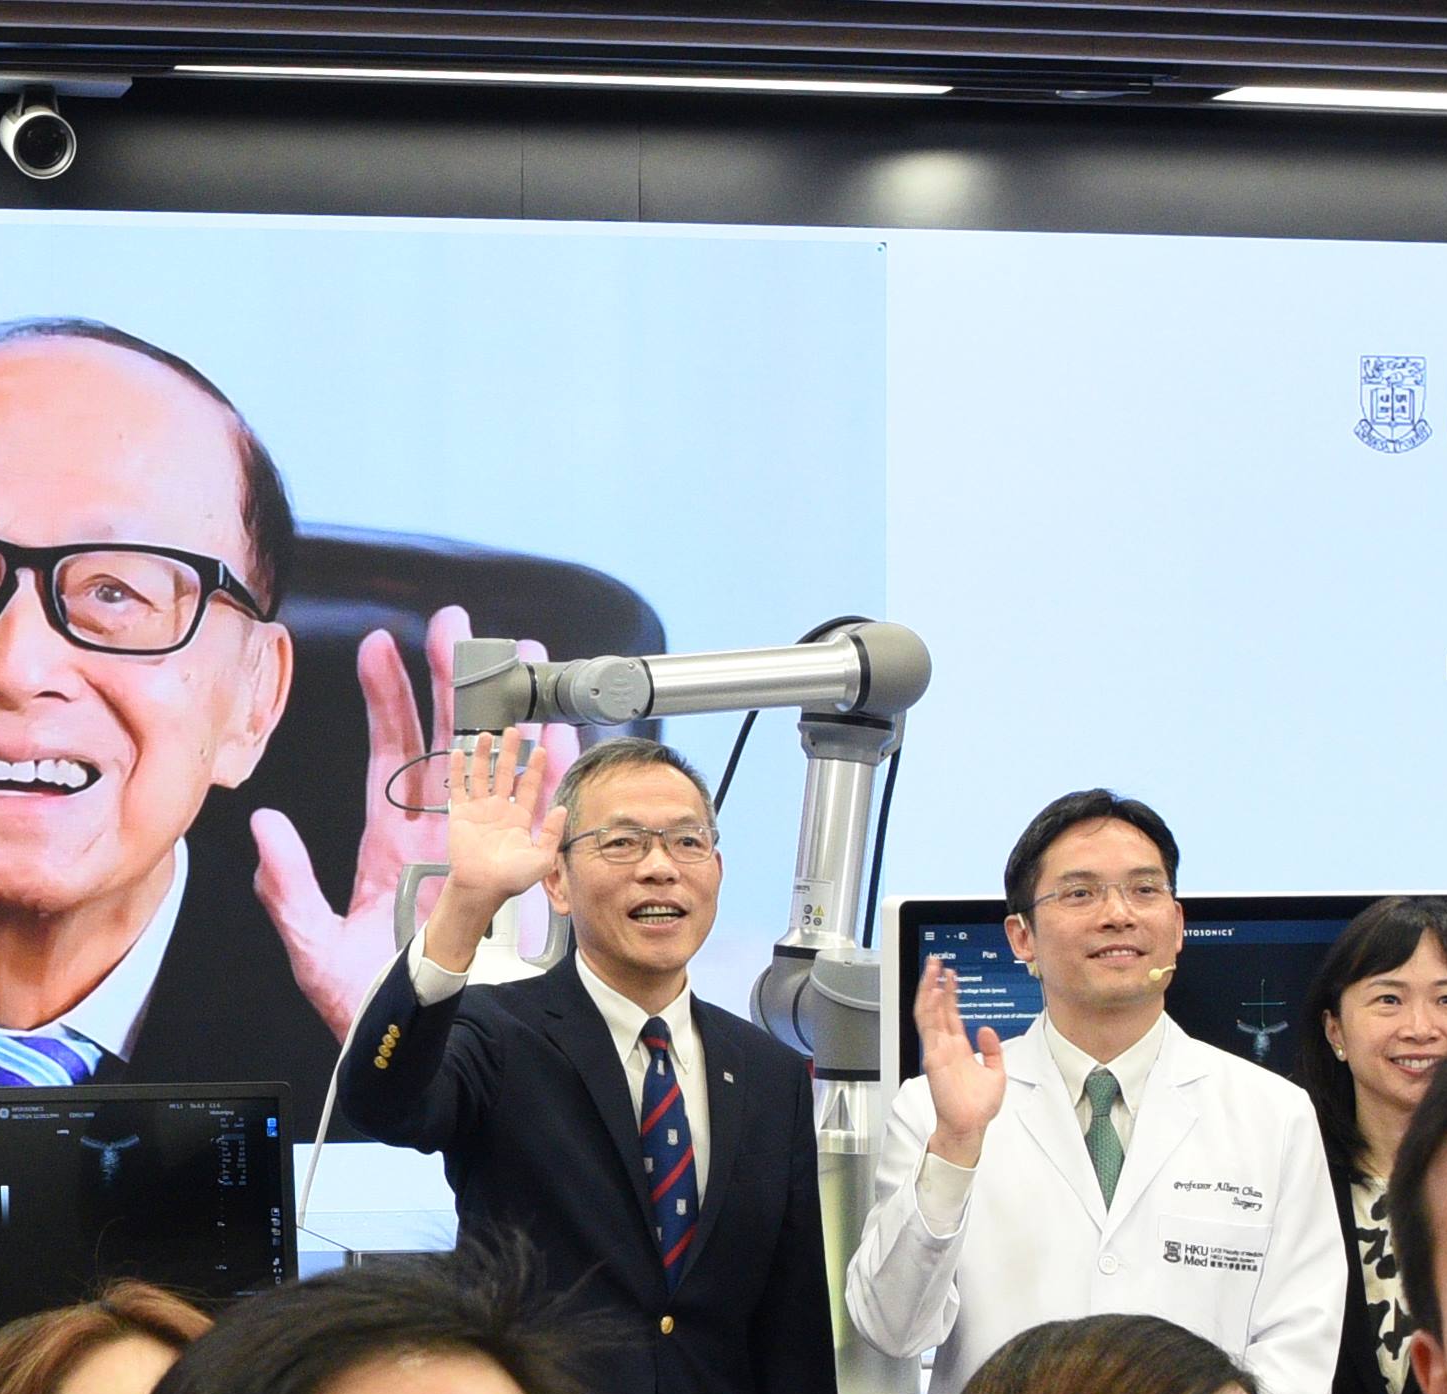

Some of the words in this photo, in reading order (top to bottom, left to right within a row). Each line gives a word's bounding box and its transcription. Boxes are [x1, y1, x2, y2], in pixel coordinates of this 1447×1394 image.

[1183, 928, 1234, 937] STOSONICS
[982, 951, 998, 960] Plan
[1184, 1244, 1209, 1256] HKU
[1184, 1255, 1208, 1267] Med
